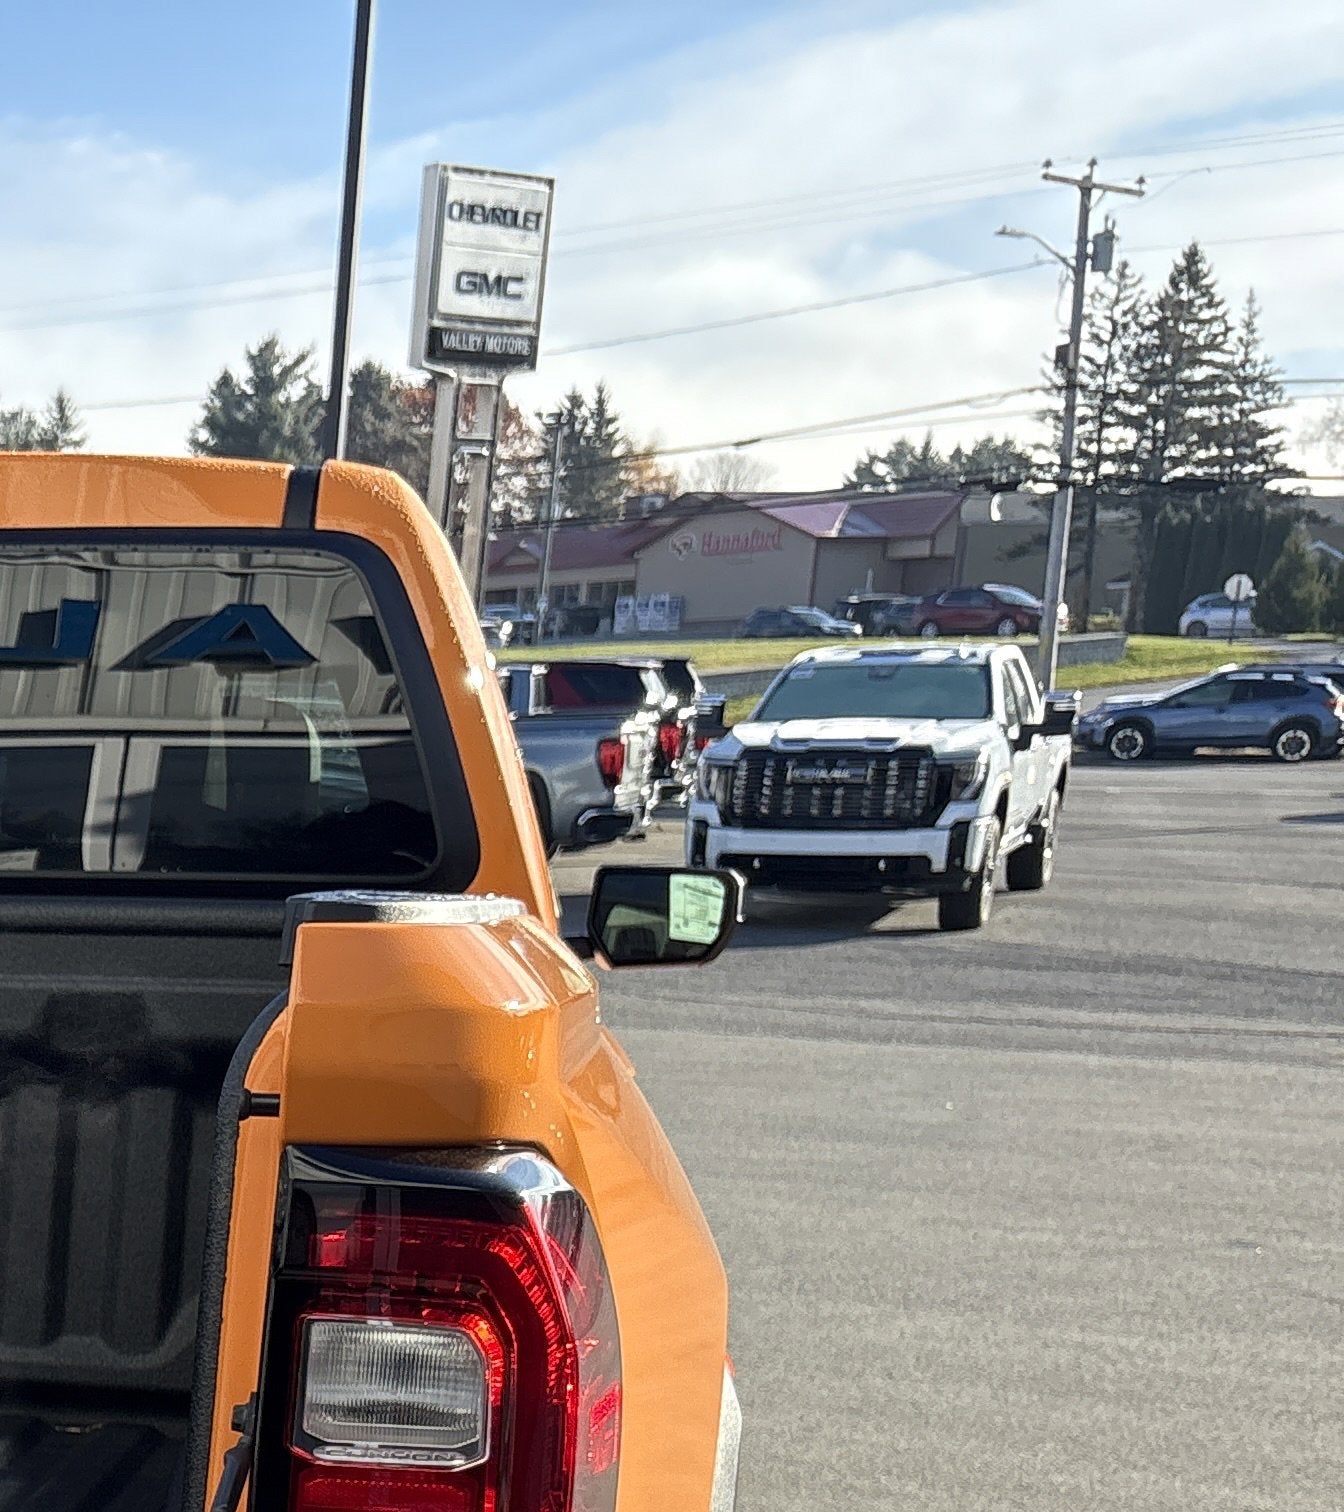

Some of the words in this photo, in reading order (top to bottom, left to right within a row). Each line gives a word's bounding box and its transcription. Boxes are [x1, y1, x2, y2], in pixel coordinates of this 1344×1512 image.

[448, 201, 542, 232] CHEVROLET
[455, 270, 524, 299] GMC
[441, 331, 482, 350] VALLEY
[485, 334, 532, 356] MOTORS
[701, 524, 784, 556] Hannaford
